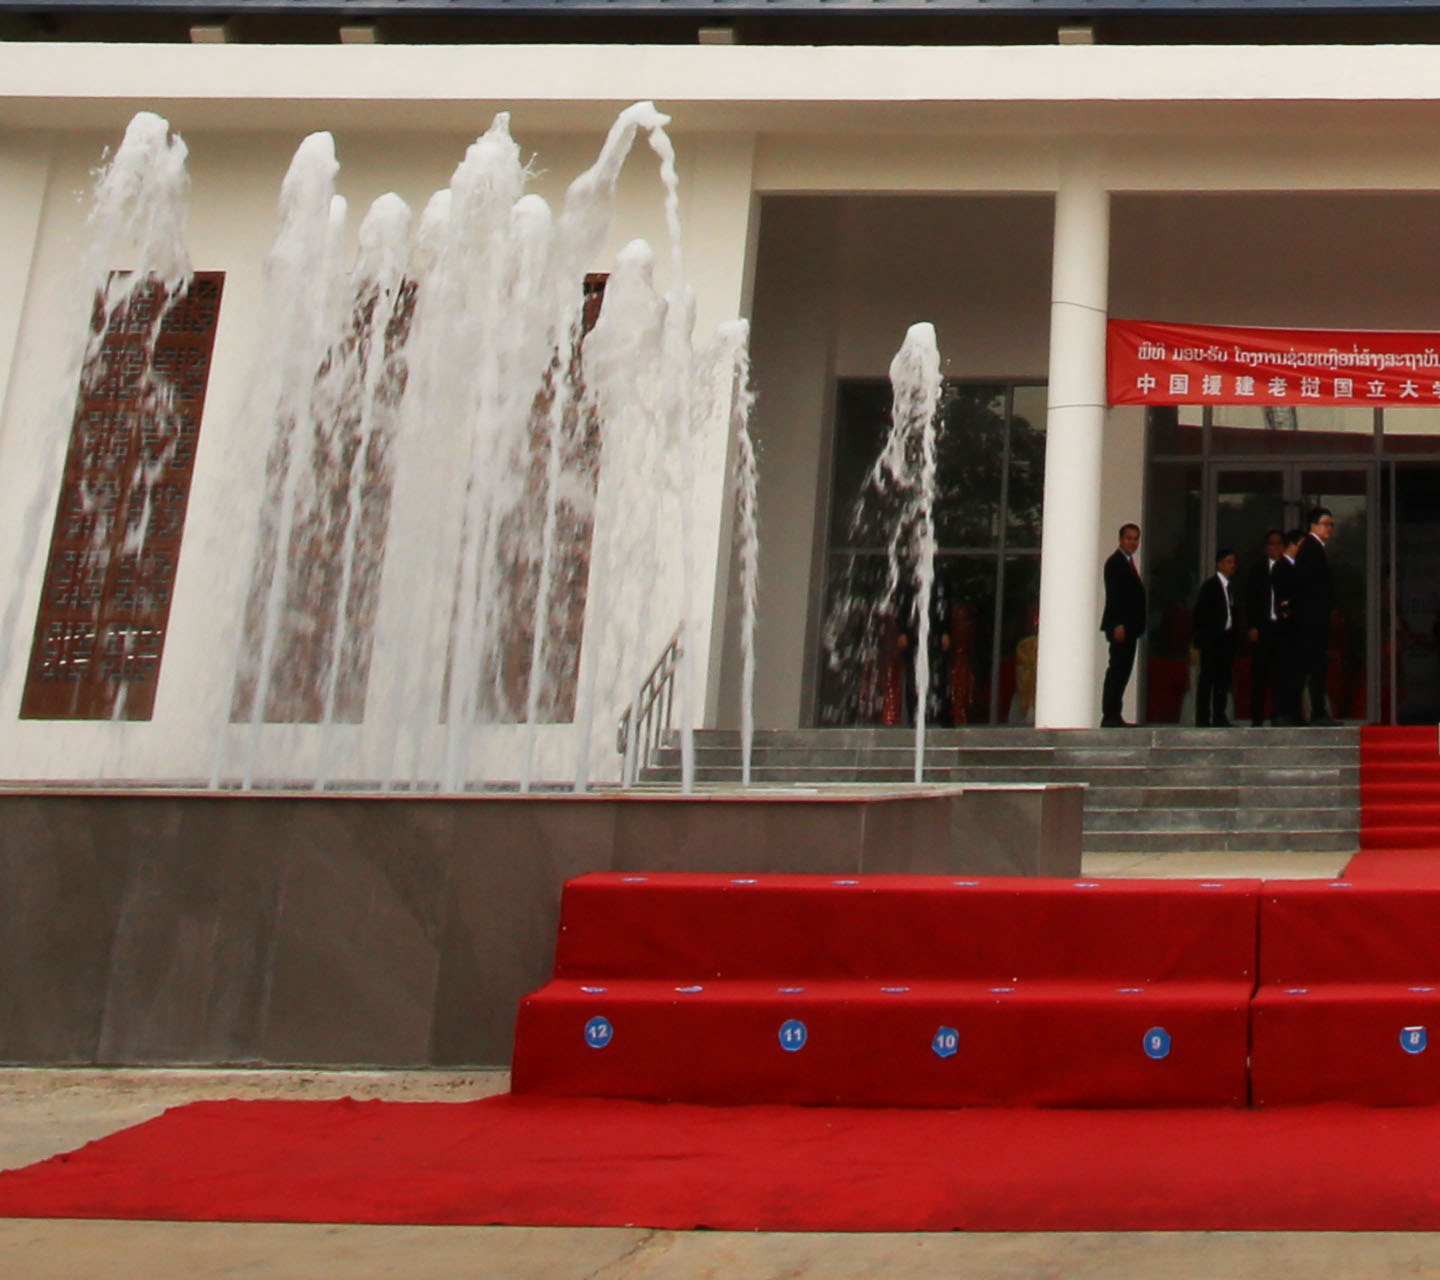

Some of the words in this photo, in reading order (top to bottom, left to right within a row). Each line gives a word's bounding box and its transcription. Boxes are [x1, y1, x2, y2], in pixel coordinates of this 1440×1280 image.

[588, 1025, 608, 1039] 12
[784, 1028, 802, 1042] 11
[1409, 1032, 1420, 1045] 8
[936, 1035, 956, 1048] 10
[1151, 1037, 1162, 1050] 9
